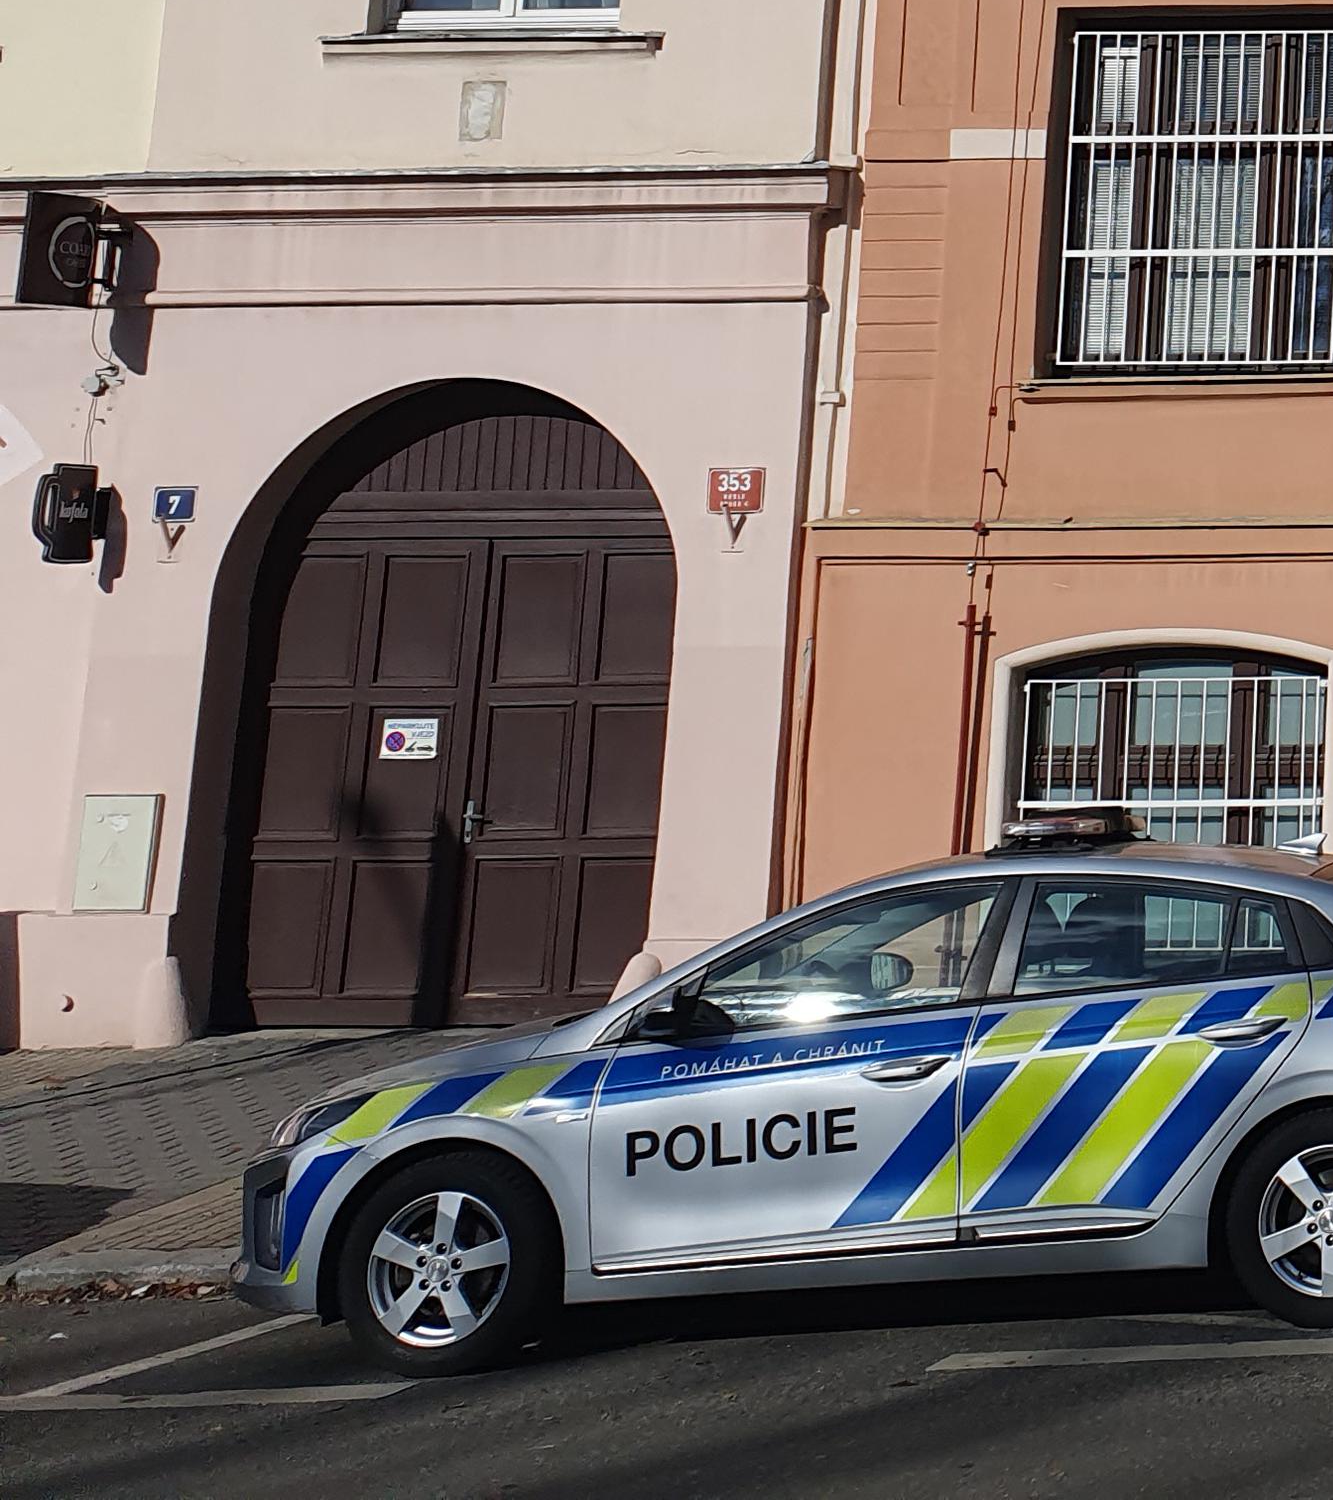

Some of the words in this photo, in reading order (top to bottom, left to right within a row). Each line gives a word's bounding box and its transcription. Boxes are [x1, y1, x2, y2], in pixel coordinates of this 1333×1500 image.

[717, 473, 751, 492] 353
[168, 495, 182, 515] 7
[660, 1054, 764, 1080] POMÁHAT
[771, 1052, 783, 1064] A
[793, 1039, 886, 1061] CHRÁNIT
[625, 1106, 858, 1178] POLICIE
